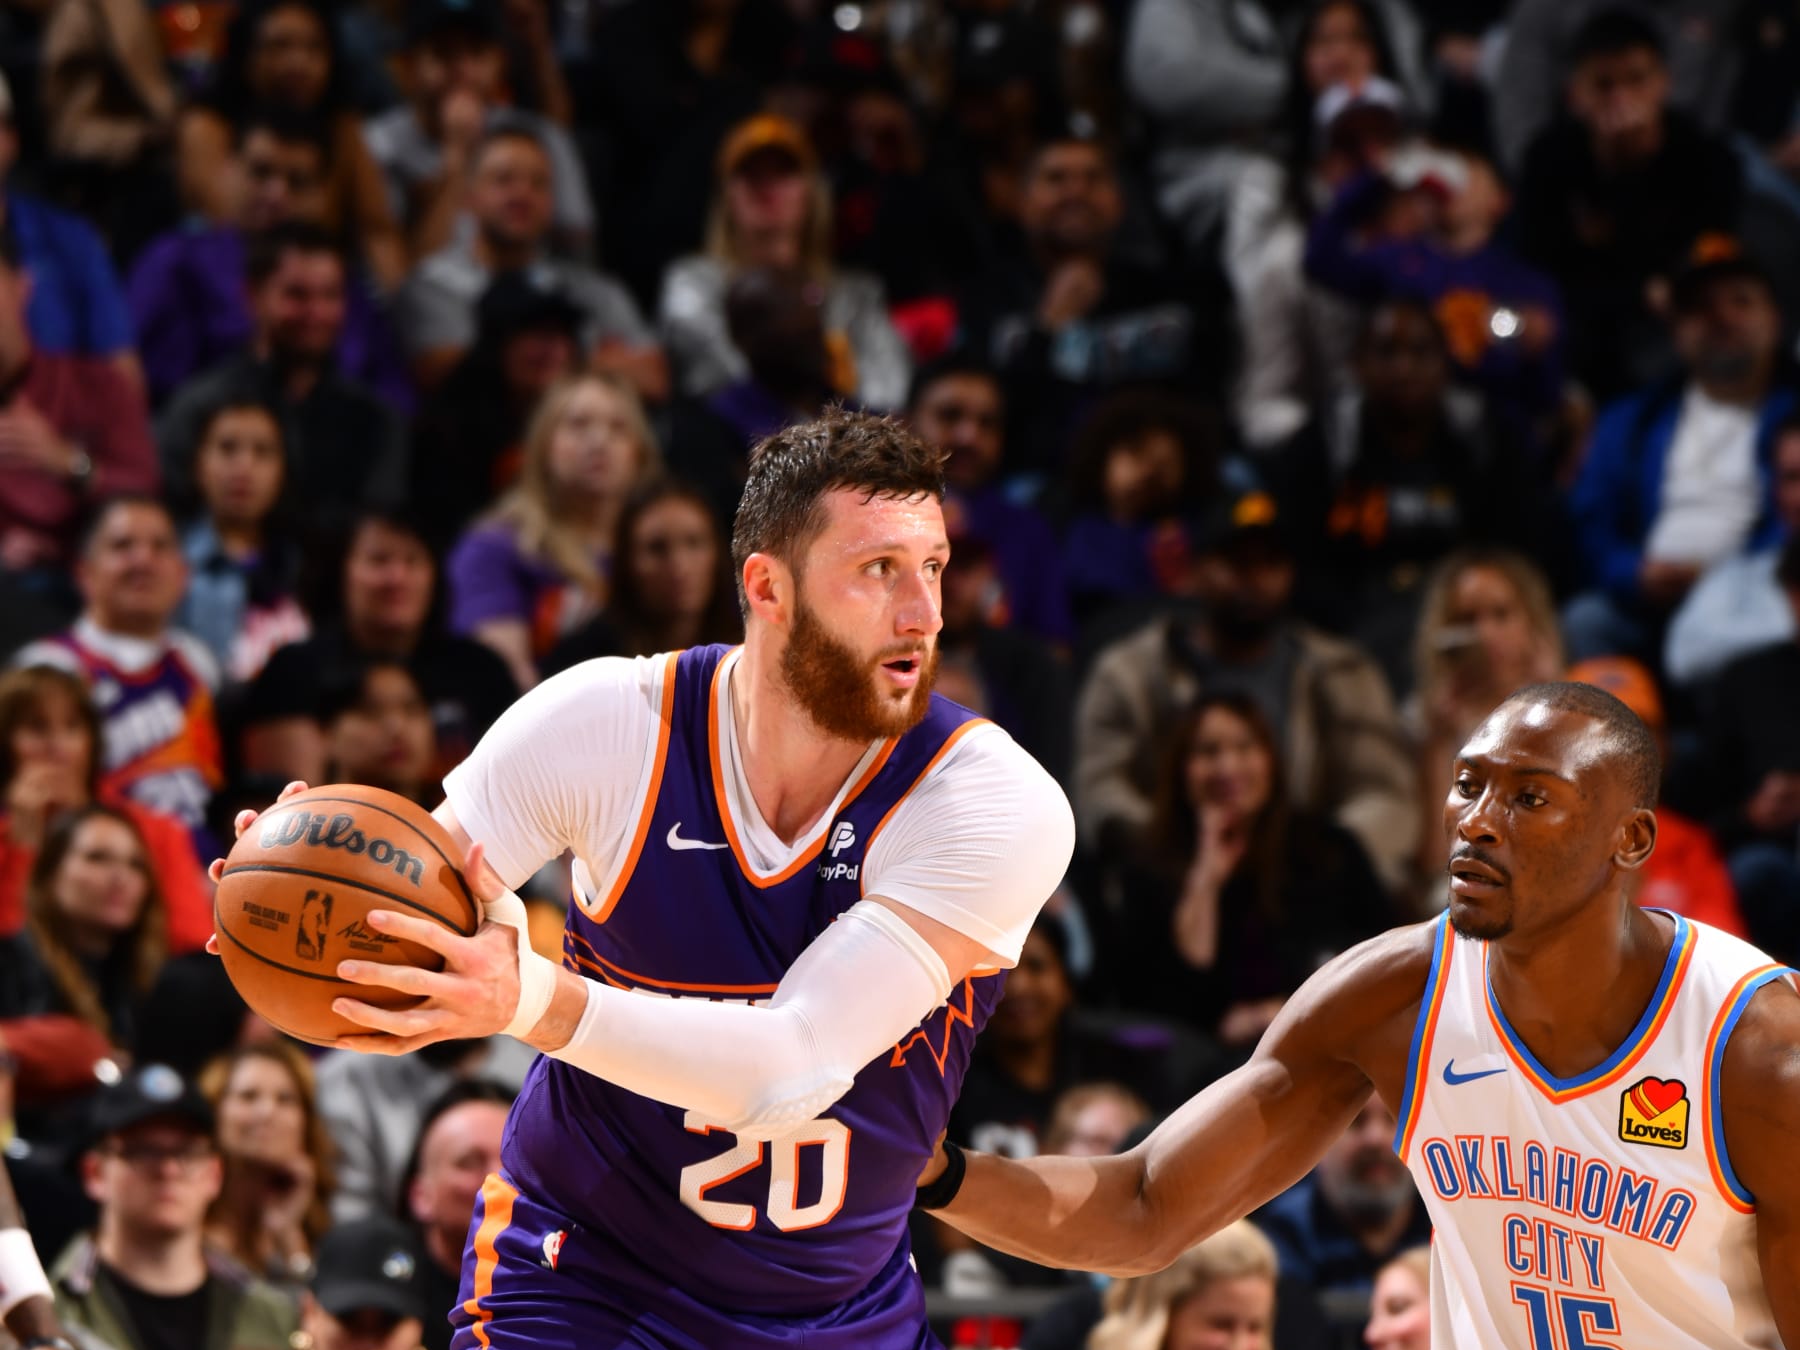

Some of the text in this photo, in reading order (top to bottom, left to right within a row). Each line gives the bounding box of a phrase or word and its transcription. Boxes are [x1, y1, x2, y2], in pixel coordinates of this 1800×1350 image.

[259, 811, 425, 888] Wilson
[679, 1110, 851, 1232] 20
[1421, 1135, 1697, 1251] OKLAHOMA
[1503, 1213, 1605, 1291] CITY
